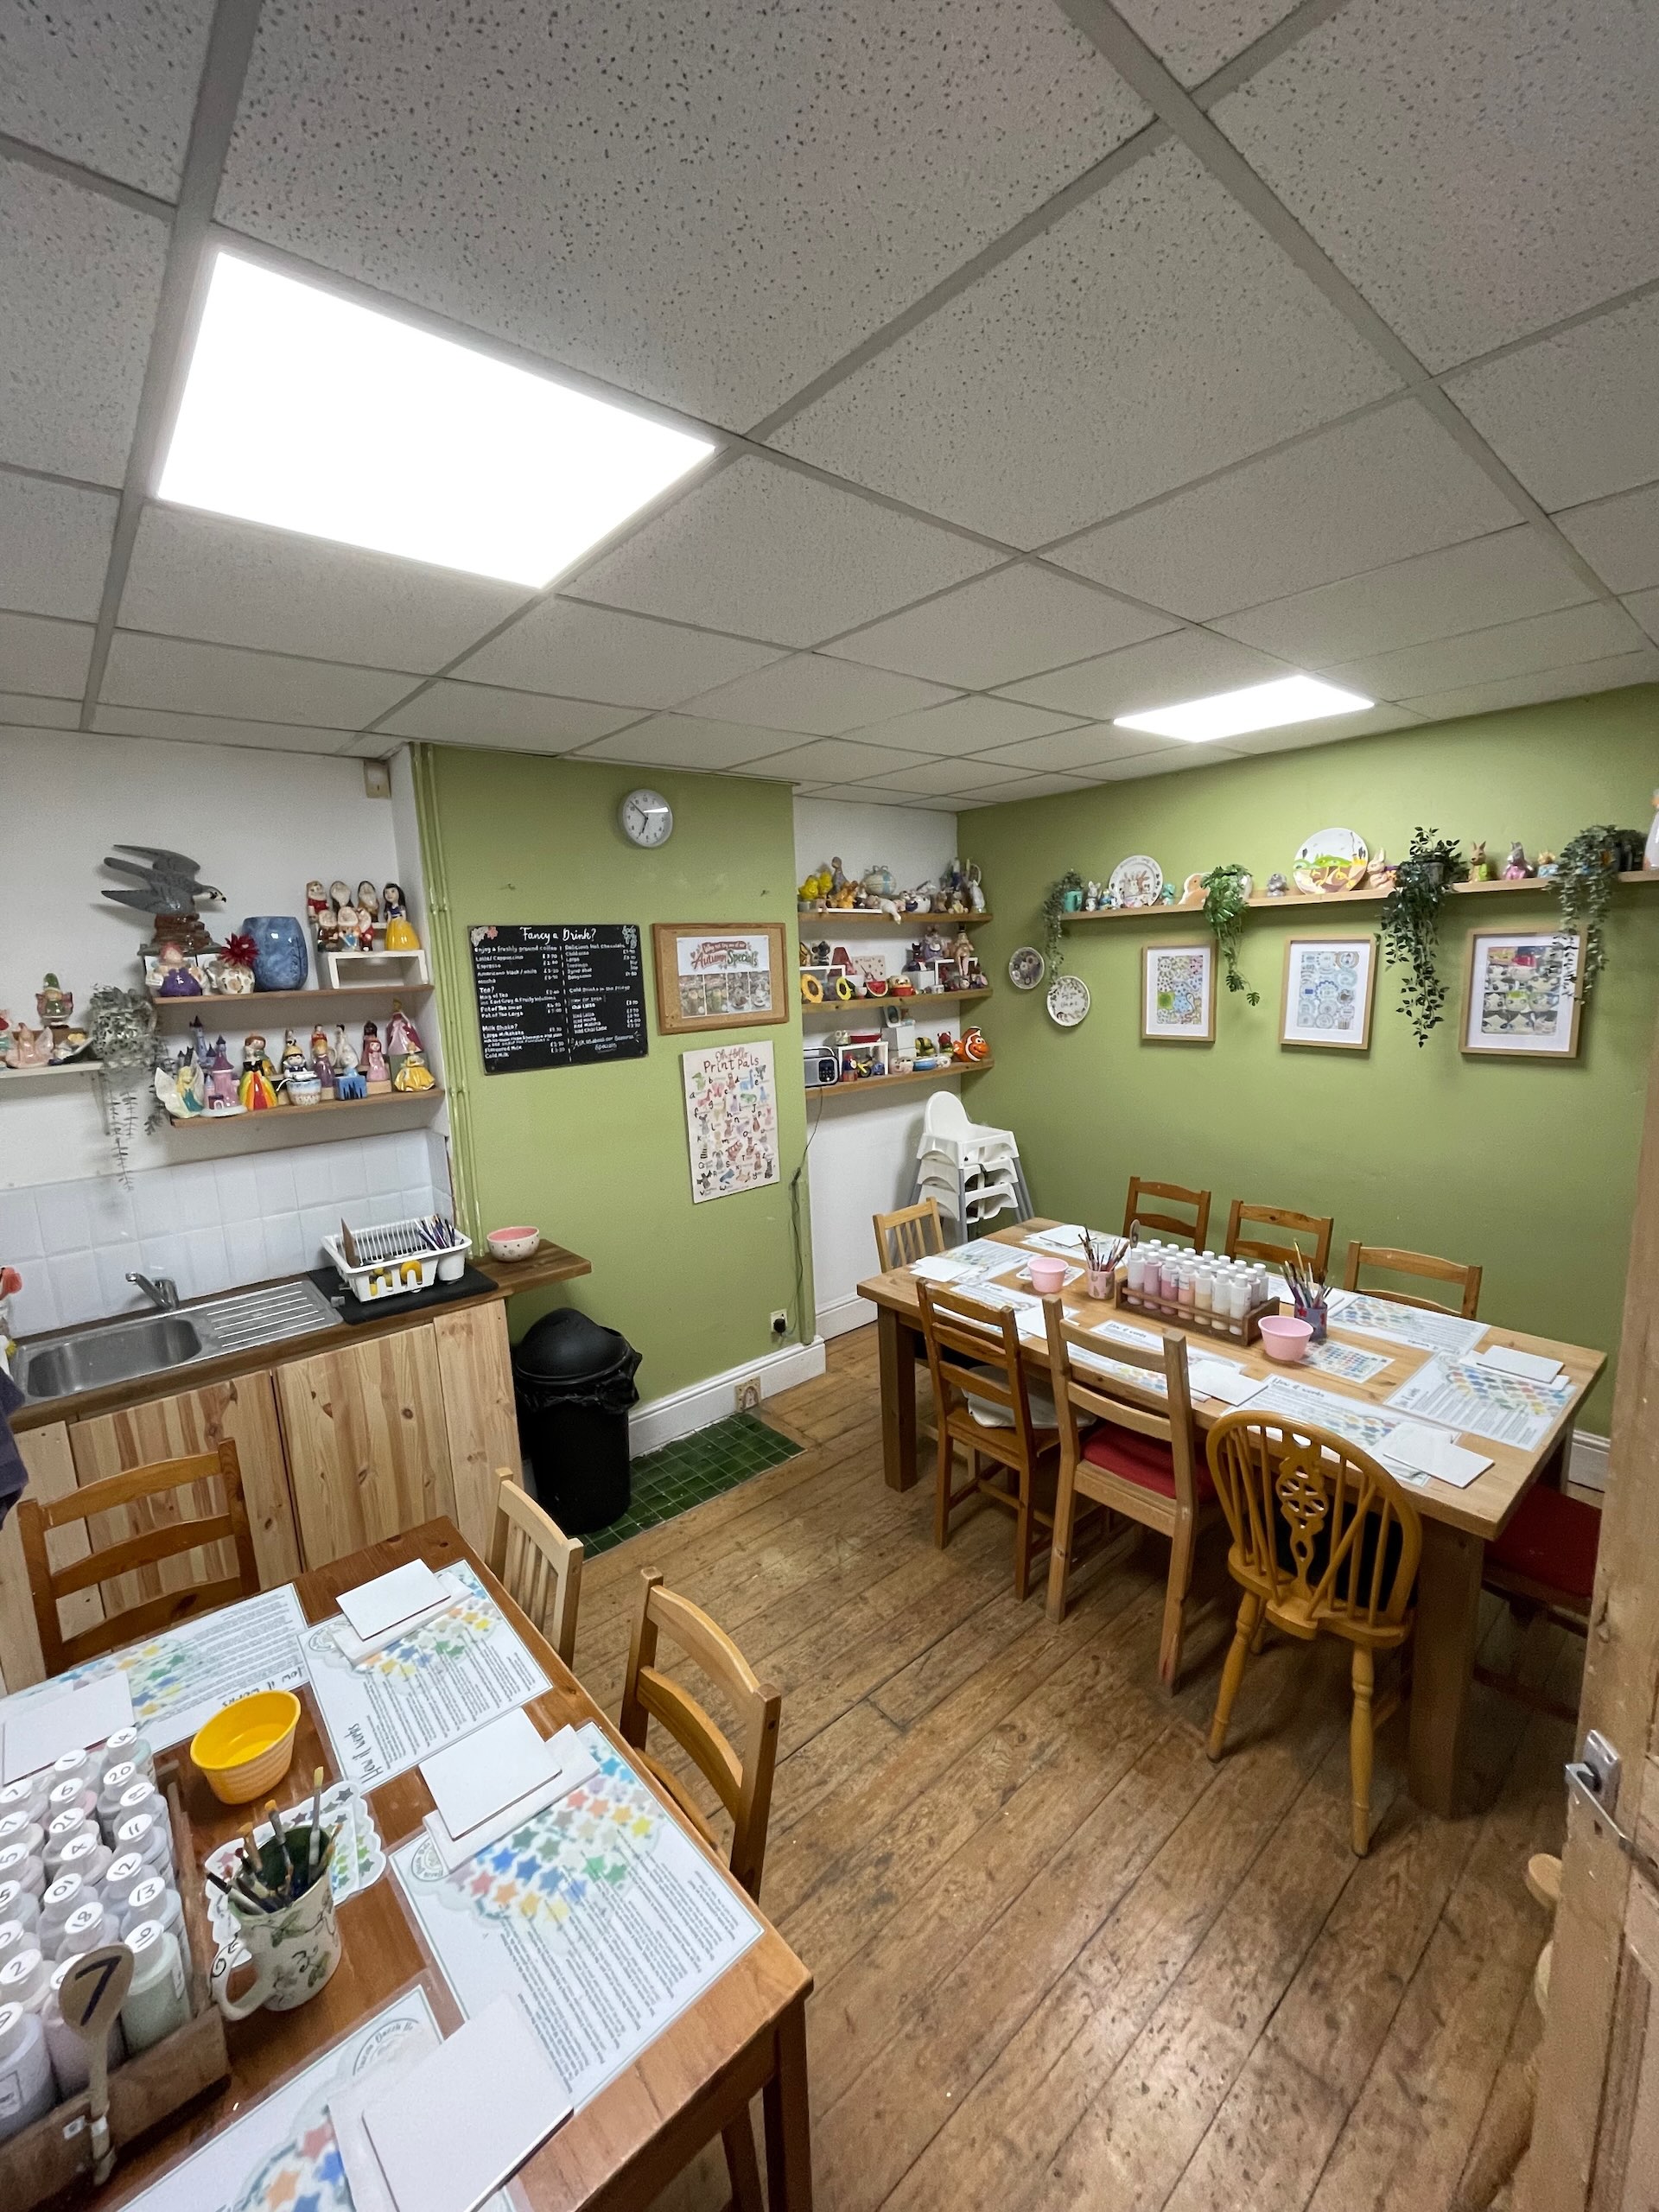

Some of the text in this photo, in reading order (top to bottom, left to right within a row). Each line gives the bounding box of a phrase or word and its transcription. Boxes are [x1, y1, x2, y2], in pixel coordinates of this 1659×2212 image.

[519, 927, 551, 945] Fancy
[563, 928, 597, 942] Drink?
[692, 950, 758, 969] Autumn Specials
[703, 1059, 734, 1073] Print
[344, 1722, 385, 1784] How it works
[109, 1765, 131, 1783] 20
[71, 1842, 87, 1854] 4
[113, 1859, 137, 1876] 12
[137, 1883, 156, 1902] 13
[72, 1910, 92, 1929] 18
[10, 1961, 26, 1977] 2
[75, 1955, 123, 2027] 7
